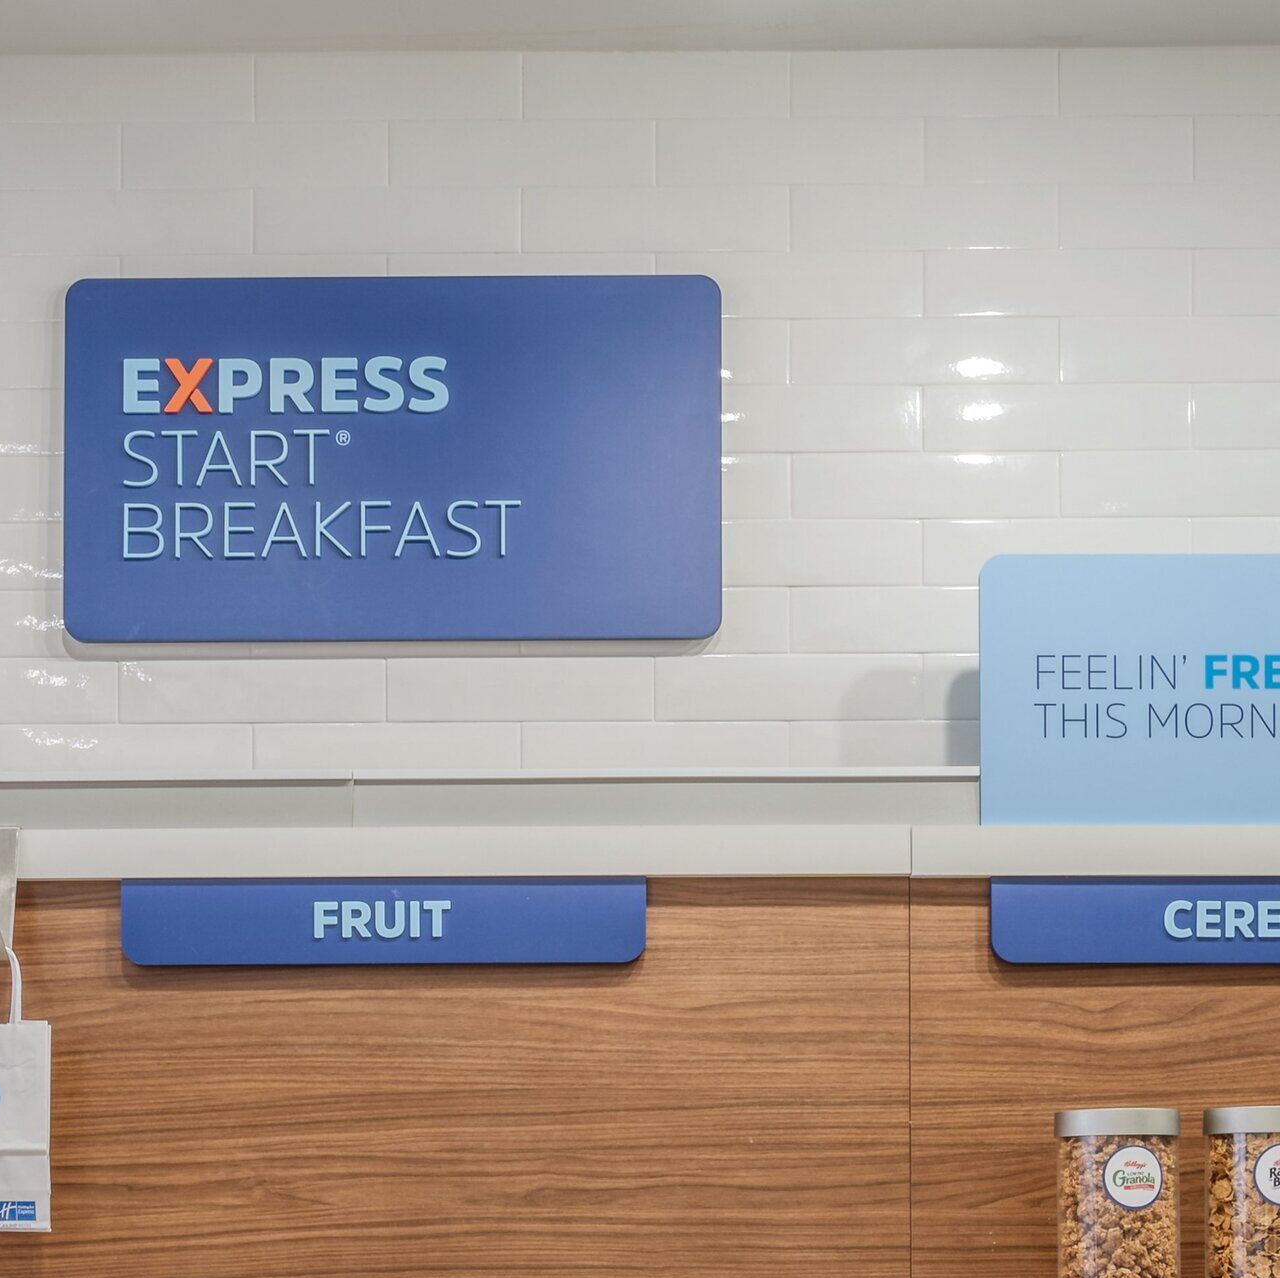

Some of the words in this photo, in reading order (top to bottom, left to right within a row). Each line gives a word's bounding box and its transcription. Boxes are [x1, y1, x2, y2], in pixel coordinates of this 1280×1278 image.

[123, 356, 450, 413] EXPRESS
[123, 500, 522, 559] BREAKFAST
[1035, 655, 1187, 690] FEELIN'
[1034, 703, 1128, 739] THIS
[313, 900, 452, 939] FRUIT
[1112, 1169, 1156, 1187] Granola
